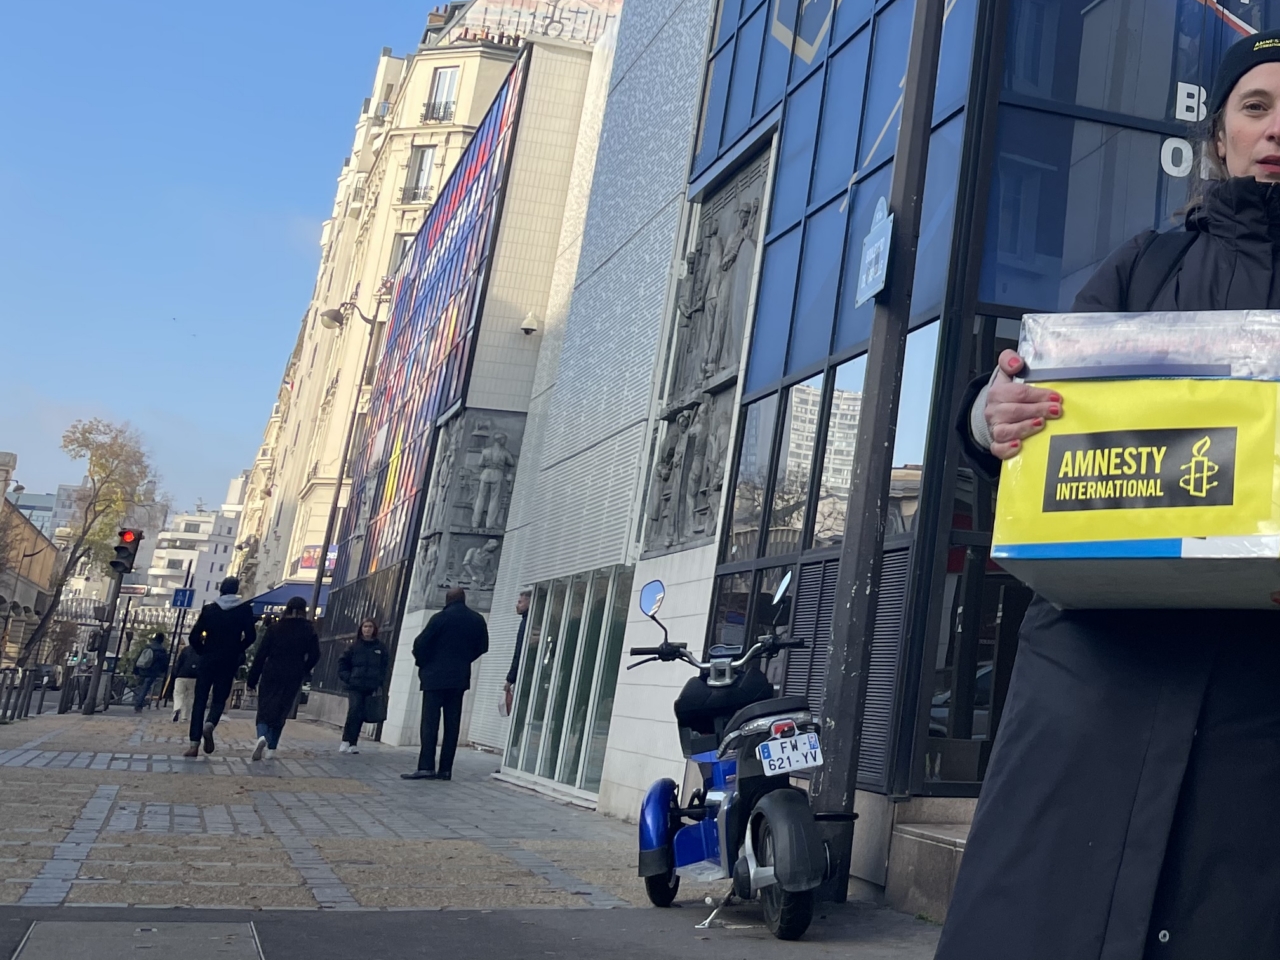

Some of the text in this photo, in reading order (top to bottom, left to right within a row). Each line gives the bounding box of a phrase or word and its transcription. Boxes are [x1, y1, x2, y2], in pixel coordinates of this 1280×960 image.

[1057, 446, 1167, 478] AMNESTY
[1055, 478, 1164, 501] INTERNATIONAL
[768, 750, 817, 771] 621-YV
